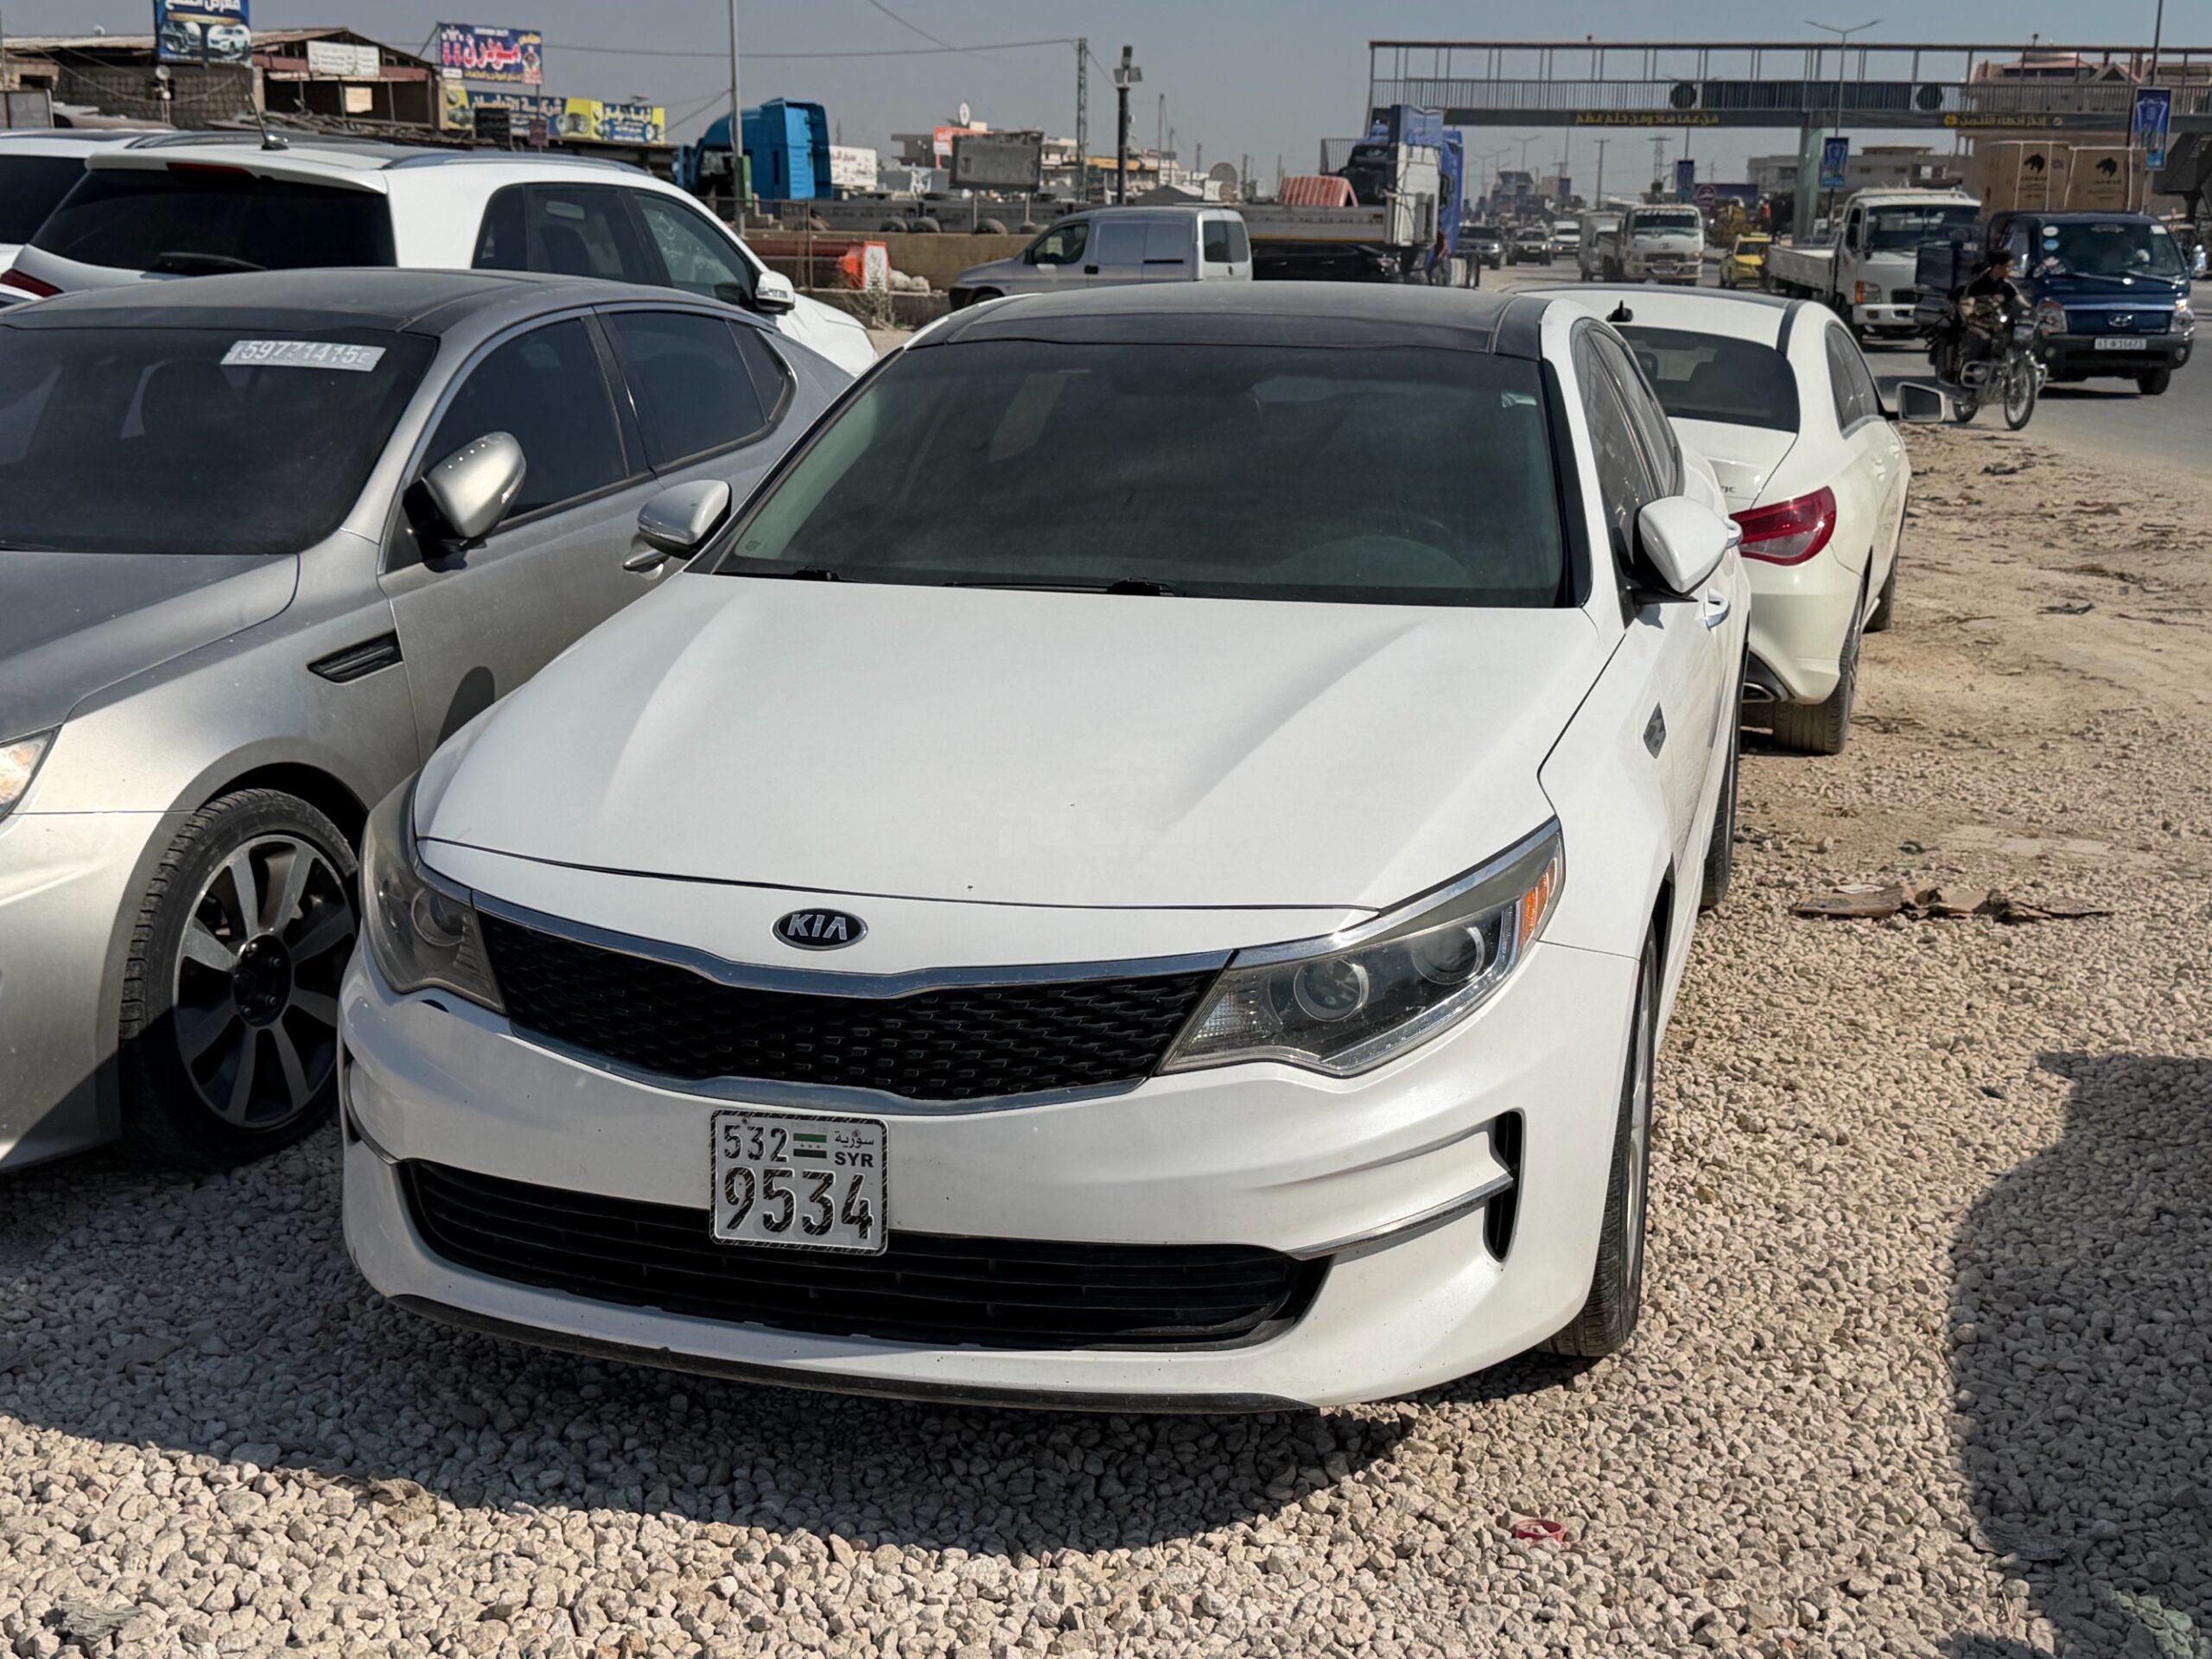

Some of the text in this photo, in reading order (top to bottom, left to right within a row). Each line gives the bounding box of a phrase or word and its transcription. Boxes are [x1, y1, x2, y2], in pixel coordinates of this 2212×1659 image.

[787, 913, 848, 941] KIA
[724, 1125, 790, 1162] 532
[833, 1130, 874, 1149] سورية
[834, 1151, 874, 1167] SYR
[724, 1166, 874, 1239] 9534
